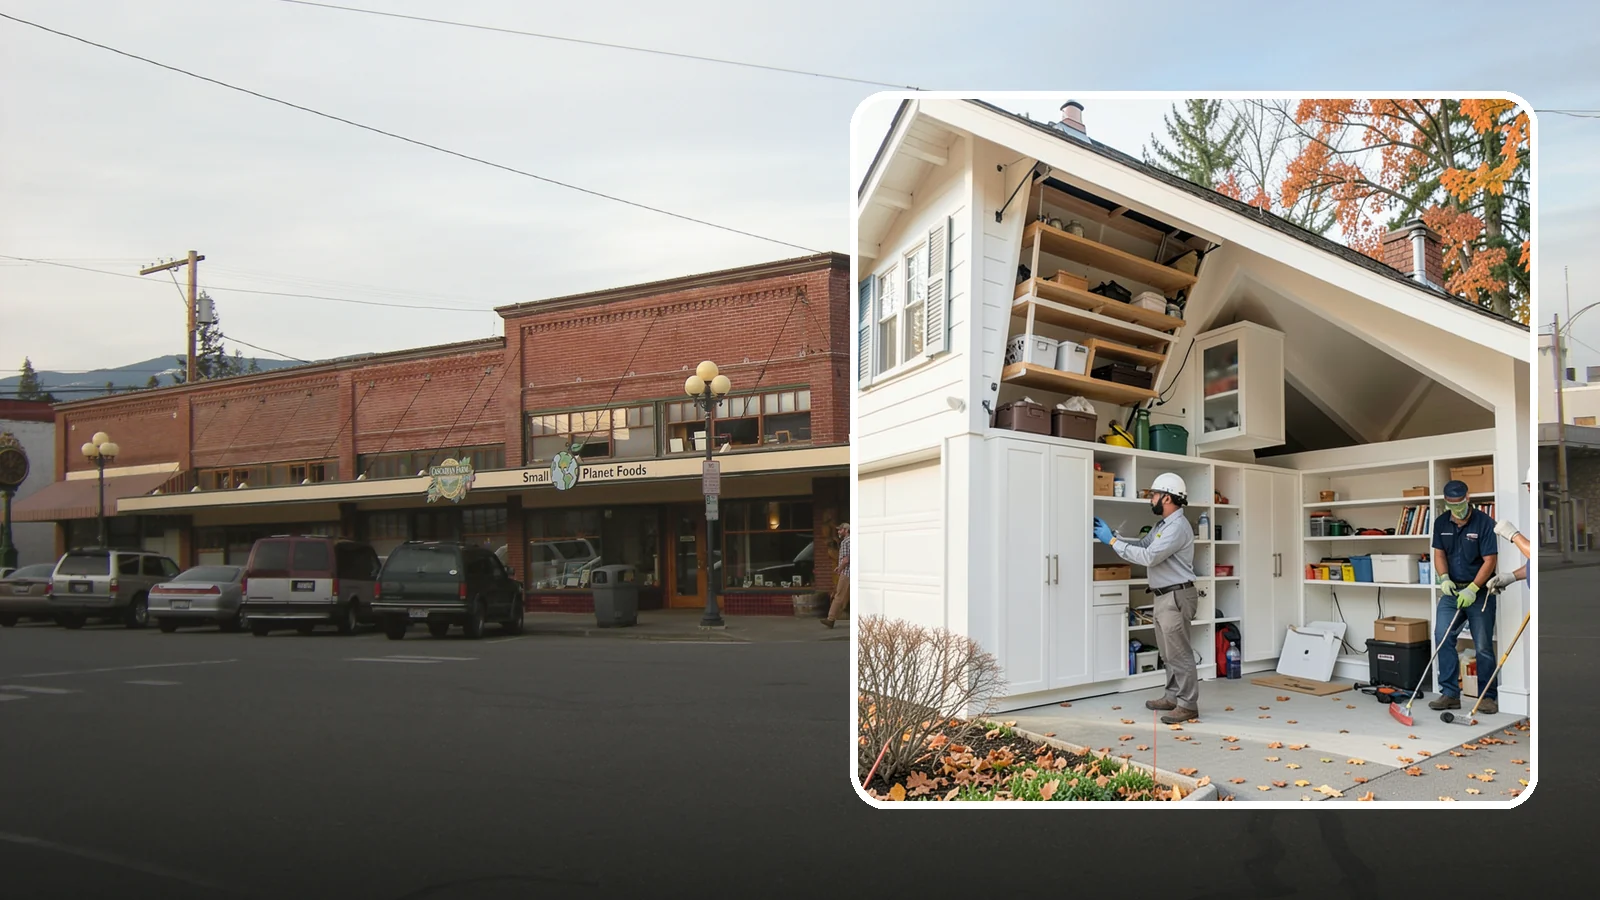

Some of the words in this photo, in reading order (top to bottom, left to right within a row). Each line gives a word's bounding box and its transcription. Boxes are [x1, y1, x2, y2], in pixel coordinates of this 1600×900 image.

[431, 467, 456, 476] CASCADIAN
[456, 466, 470, 474] FARM
[523, 470, 549, 483] Small
[583, 468, 614, 480] Planet
[617, 464, 647, 477] Foods
